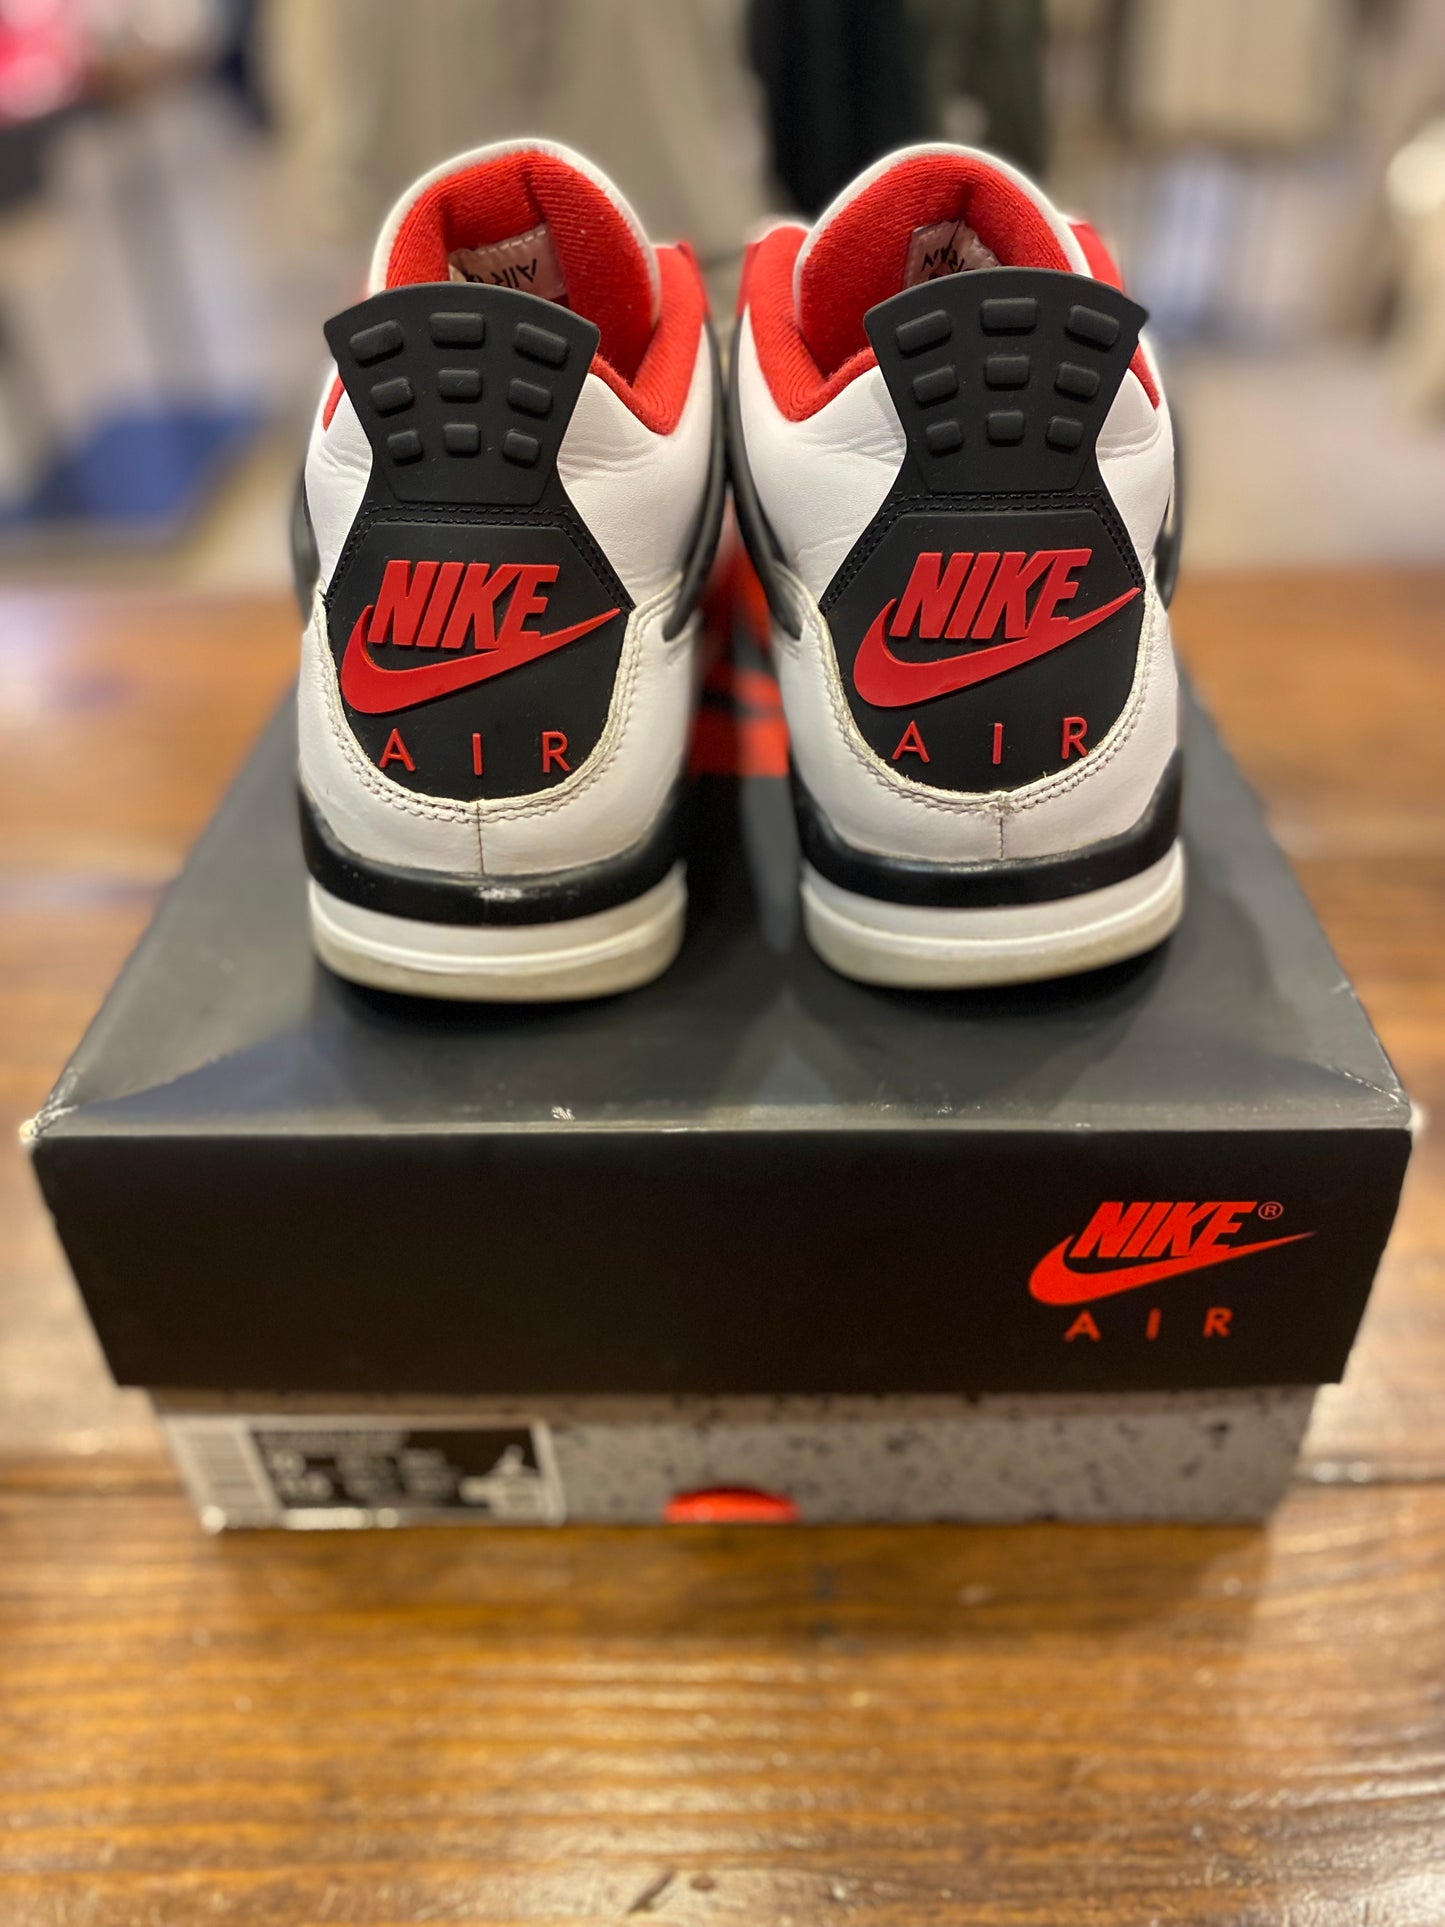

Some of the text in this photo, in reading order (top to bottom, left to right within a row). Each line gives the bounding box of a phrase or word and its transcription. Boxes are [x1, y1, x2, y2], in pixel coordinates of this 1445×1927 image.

[367, 559, 560, 650] NIKE
[889, 548, 1093, 640] NIKE
[379, 727, 572, 776] AIR
[892, 716, 1089, 765] AIR
[1064, 1306, 1234, 1343] AIR
